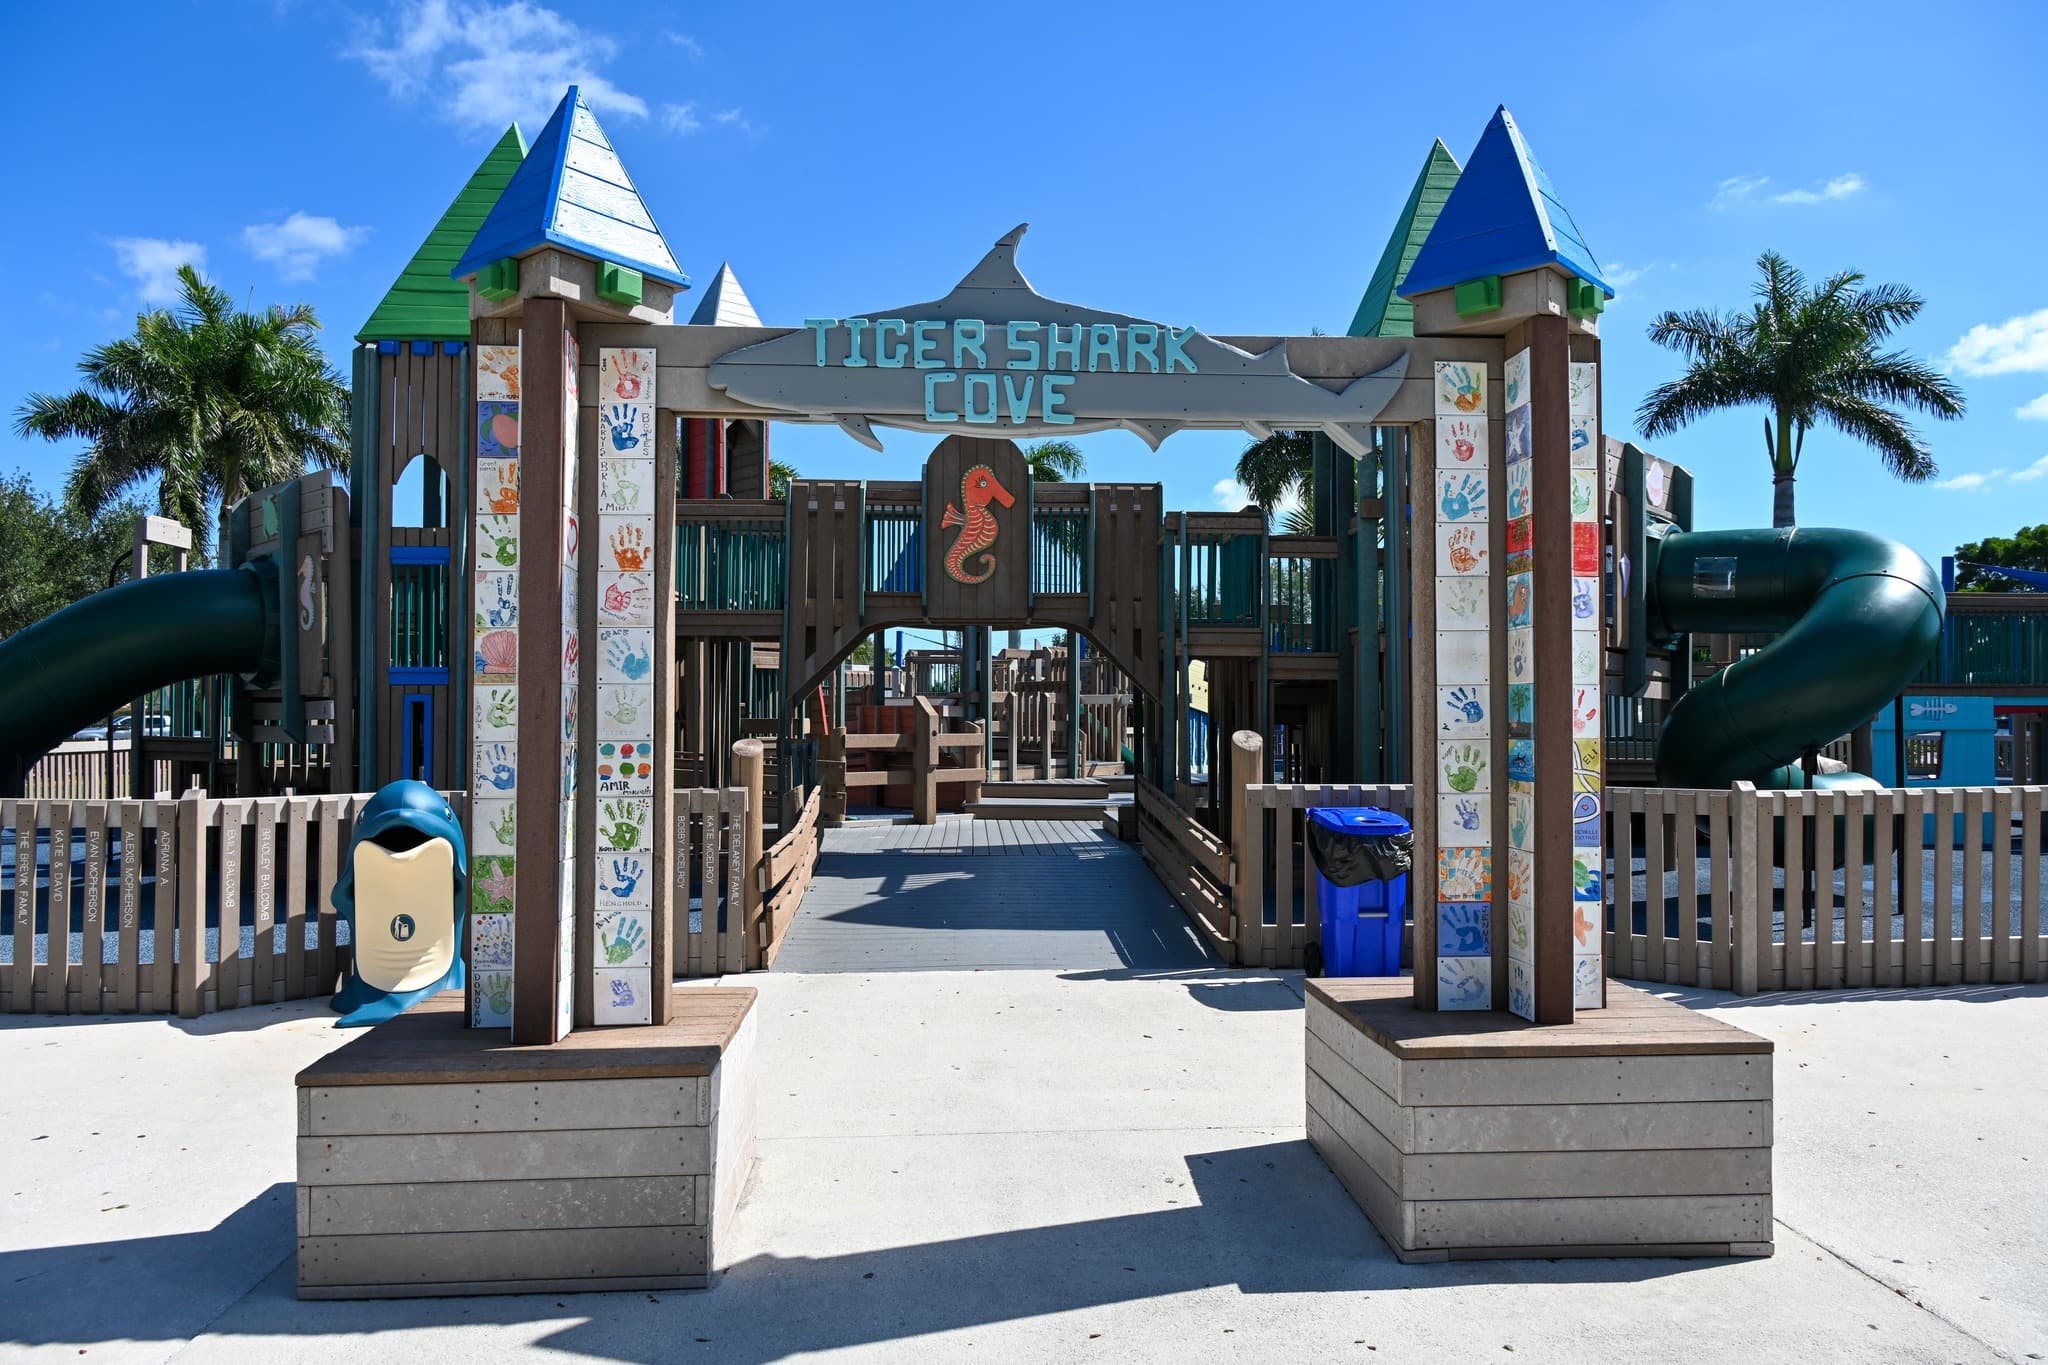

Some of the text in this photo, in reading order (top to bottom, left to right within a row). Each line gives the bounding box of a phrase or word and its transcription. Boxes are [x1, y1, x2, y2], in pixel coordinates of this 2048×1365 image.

[804, 319, 1199, 374] TIGER SHARK
[924, 373, 1076, 425] COVE
[600, 781, 631, 792] AMIR
[1582, 748, 1598, 765] ELI
[20, 830, 30, 849] THE
[53, 829, 64, 902] KATE & DAVID
[160, 830, 170, 873] ADRIANA
[225, 829, 236, 908] EMILY BALCOMB
[677, 815, 686, 889] BOBBY MCELROY
[706, 815, 714, 884] KATE MCELROY
[731, 813, 741, 906] THE DELANEY FAMILY
[87, 831, 100, 922] EVAN MCPHERSON
[123, 831, 135, 928] ALEXIS MCPHERSON
[260, 827, 271, 921] BRADLEY BALCOMB
[18, 890, 29, 926] FAMILY
[473, 973, 481, 1026] DONOVAN
